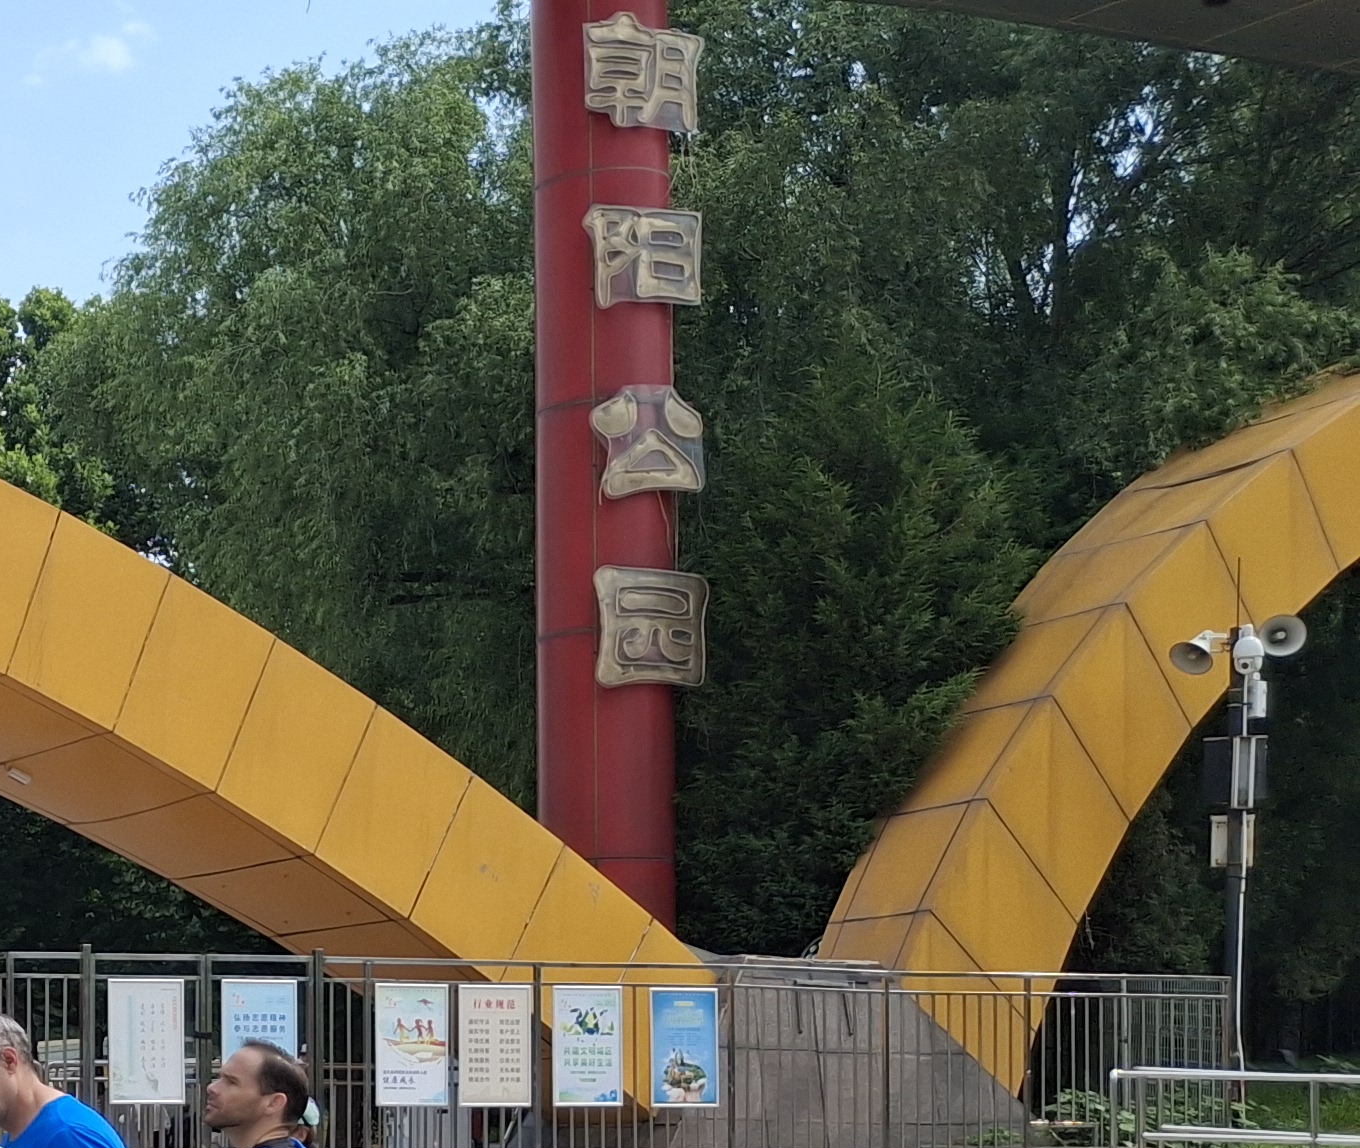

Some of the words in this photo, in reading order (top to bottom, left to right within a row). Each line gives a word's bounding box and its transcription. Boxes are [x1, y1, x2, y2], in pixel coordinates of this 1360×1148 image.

[473, 998, 516, 1010] 行业规范
[233, 1013, 287, 1023] 弘扬志愿精神
